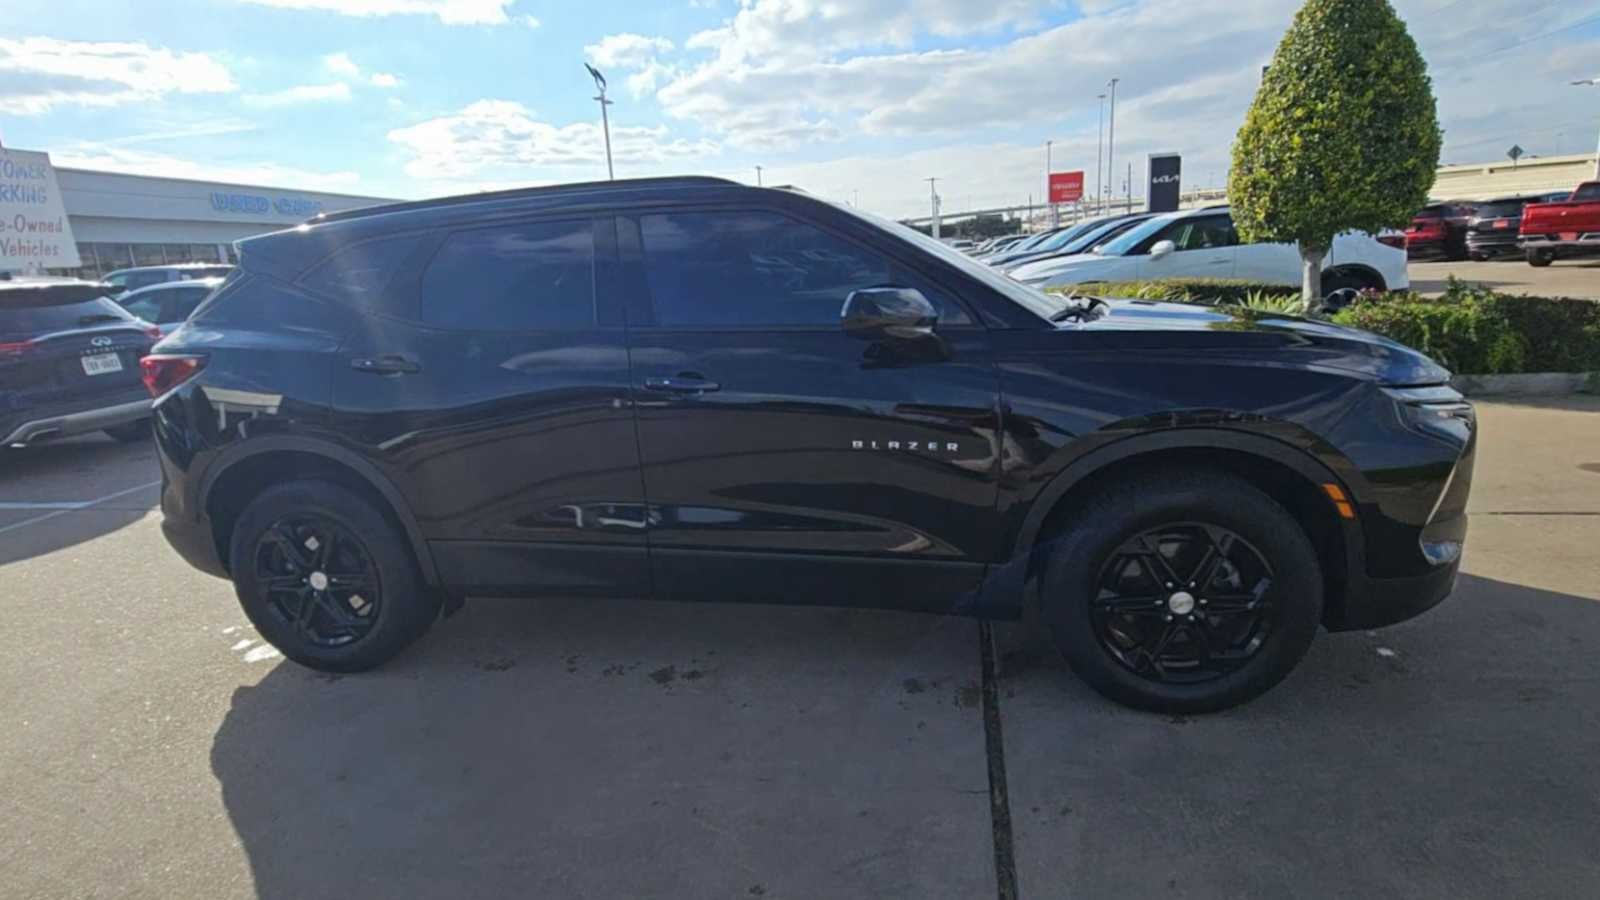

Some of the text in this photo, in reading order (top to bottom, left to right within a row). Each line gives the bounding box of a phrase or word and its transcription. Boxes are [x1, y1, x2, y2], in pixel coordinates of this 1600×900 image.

[209, 190, 270, 214] USED
[0, 237, 60, 257] Vehicles
[851, 440, 960, 452] BLAZER
